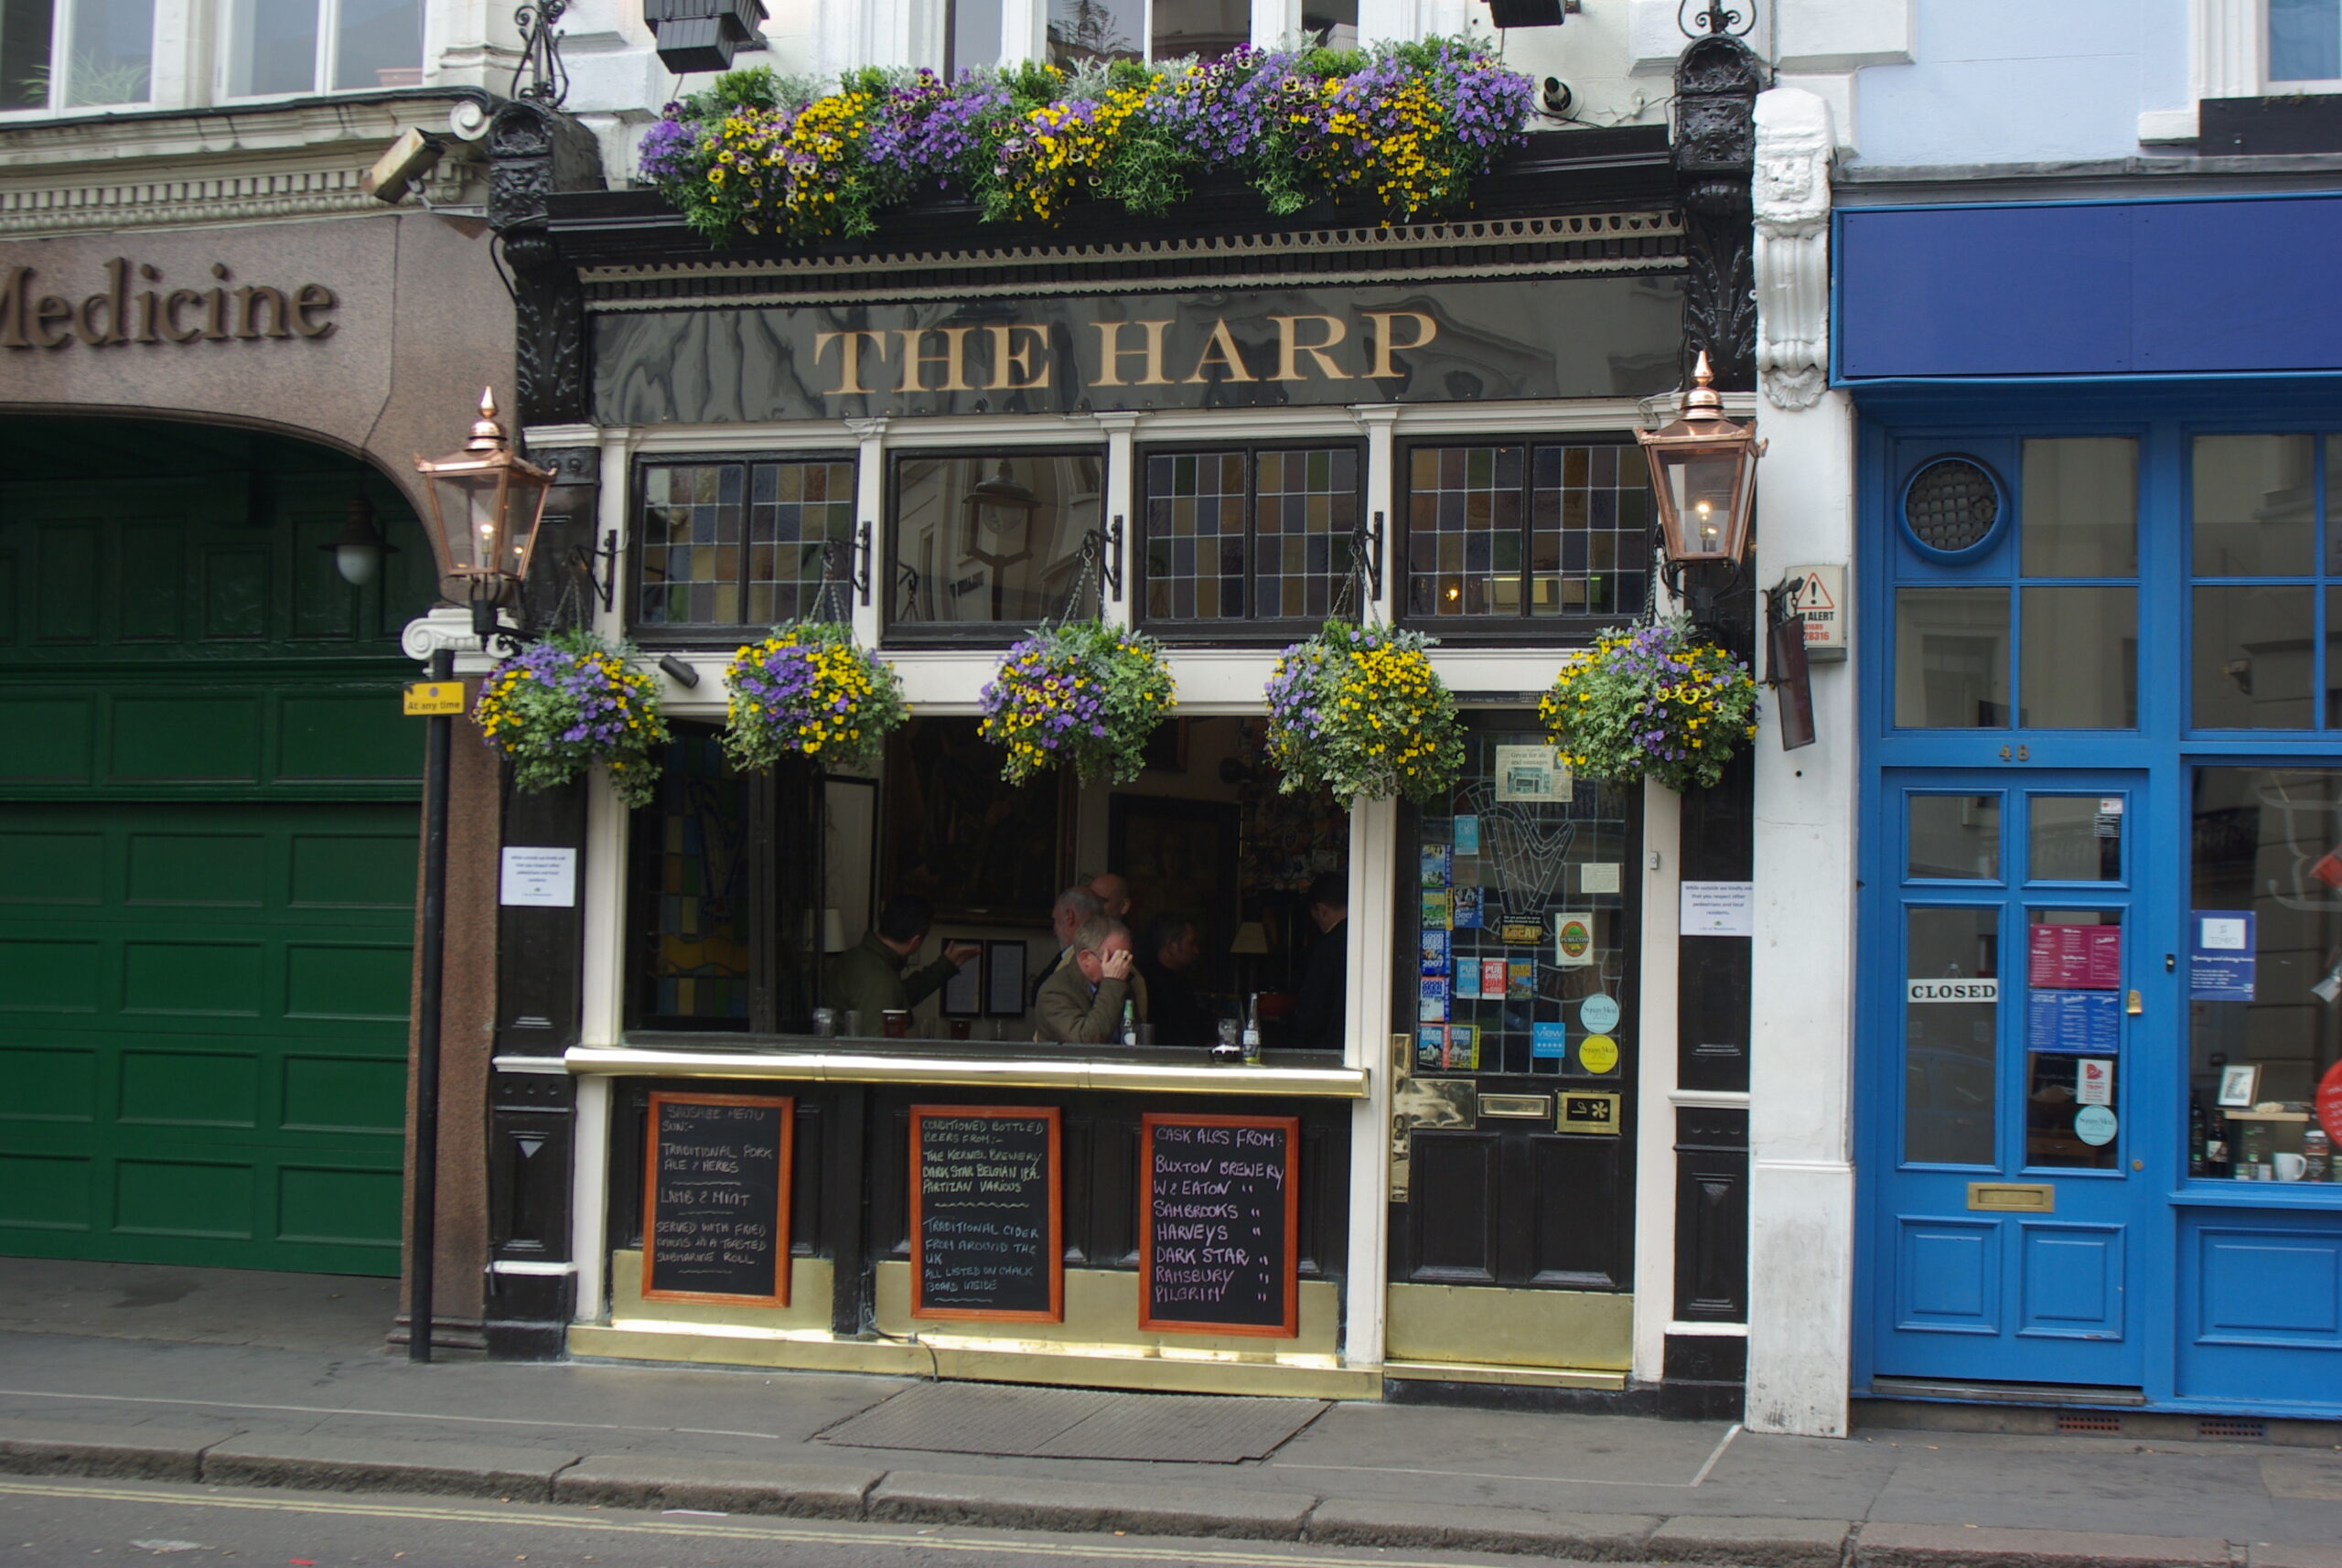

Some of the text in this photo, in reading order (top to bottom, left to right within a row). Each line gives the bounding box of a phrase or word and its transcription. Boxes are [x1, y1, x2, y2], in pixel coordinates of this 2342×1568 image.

[814, 312, 1437, 395] THE HARP
[1808, 611, 1834, 621] ALERT
[408, 701, 460, 711] At any time
[1998, 744, 2030, 762] 48
[1486, 965, 1502, 974] PUB
[1911, 985, 1996, 998] CLOSED
[667, 1105, 721, 1120] SAUSAGE
[922, 1119, 1044, 1135] CONDITIONED BOTTLED
[923, 1132, 960, 1143] BEERS
[1155, 1127, 1192, 1143] CASK
[1197, 1128, 1230, 1144] ALES
[661, 1143, 773, 1160] TRADITIONAL PORK
[922, 1148, 1043, 1168] THE KERNEL BREWERY
[664, 1159, 686, 1171] ALE
[703, 1160, 739, 1174] HERBS
[922, 1165, 949, 1178] DARK
[950, 1165, 973, 1177] STAR
[976, 1163, 1016, 1178] BELGIAN
[1155, 1155, 1284, 1190] BUXTON BREWERY
[922, 1178, 1022, 1194] PARTIZAN VARIOUS
[1181, 1180, 1231, 1196] EATON
[661, 1187, 693, 1205] LAMB
[1153, 1199, 1239, 1219] SAMBROOKS
[656, 1221, 766, 1237] SERVED WITH FRIED
[922, 1216, 1039, 1239] TRADITIONAL CIDER
[1157, 1223, 1229, 1247] HARVEYS
[709, 1238, 717, 1248] A
[720, 1237, 767, 1251] TOASTED
[925, 1239, 1037, 1255] FROM AROUND THE
[657, 1251, 714, 1262] SUBMARINE
[925, 1252, 943, 1265] UK
[1156, 1246, 1197, 1265] DARK
[1202, 1248, 1250, 1266] STAR
[925, 1265, 1034, 1280] ALL LISTED ON CHALK
[1155, 1265, 1235, 1294] RAMSBURY
[925, 1279, 998, 1293] BOARD INSIDE
[1155, 1285, 1220, 1303] PILGRIM
